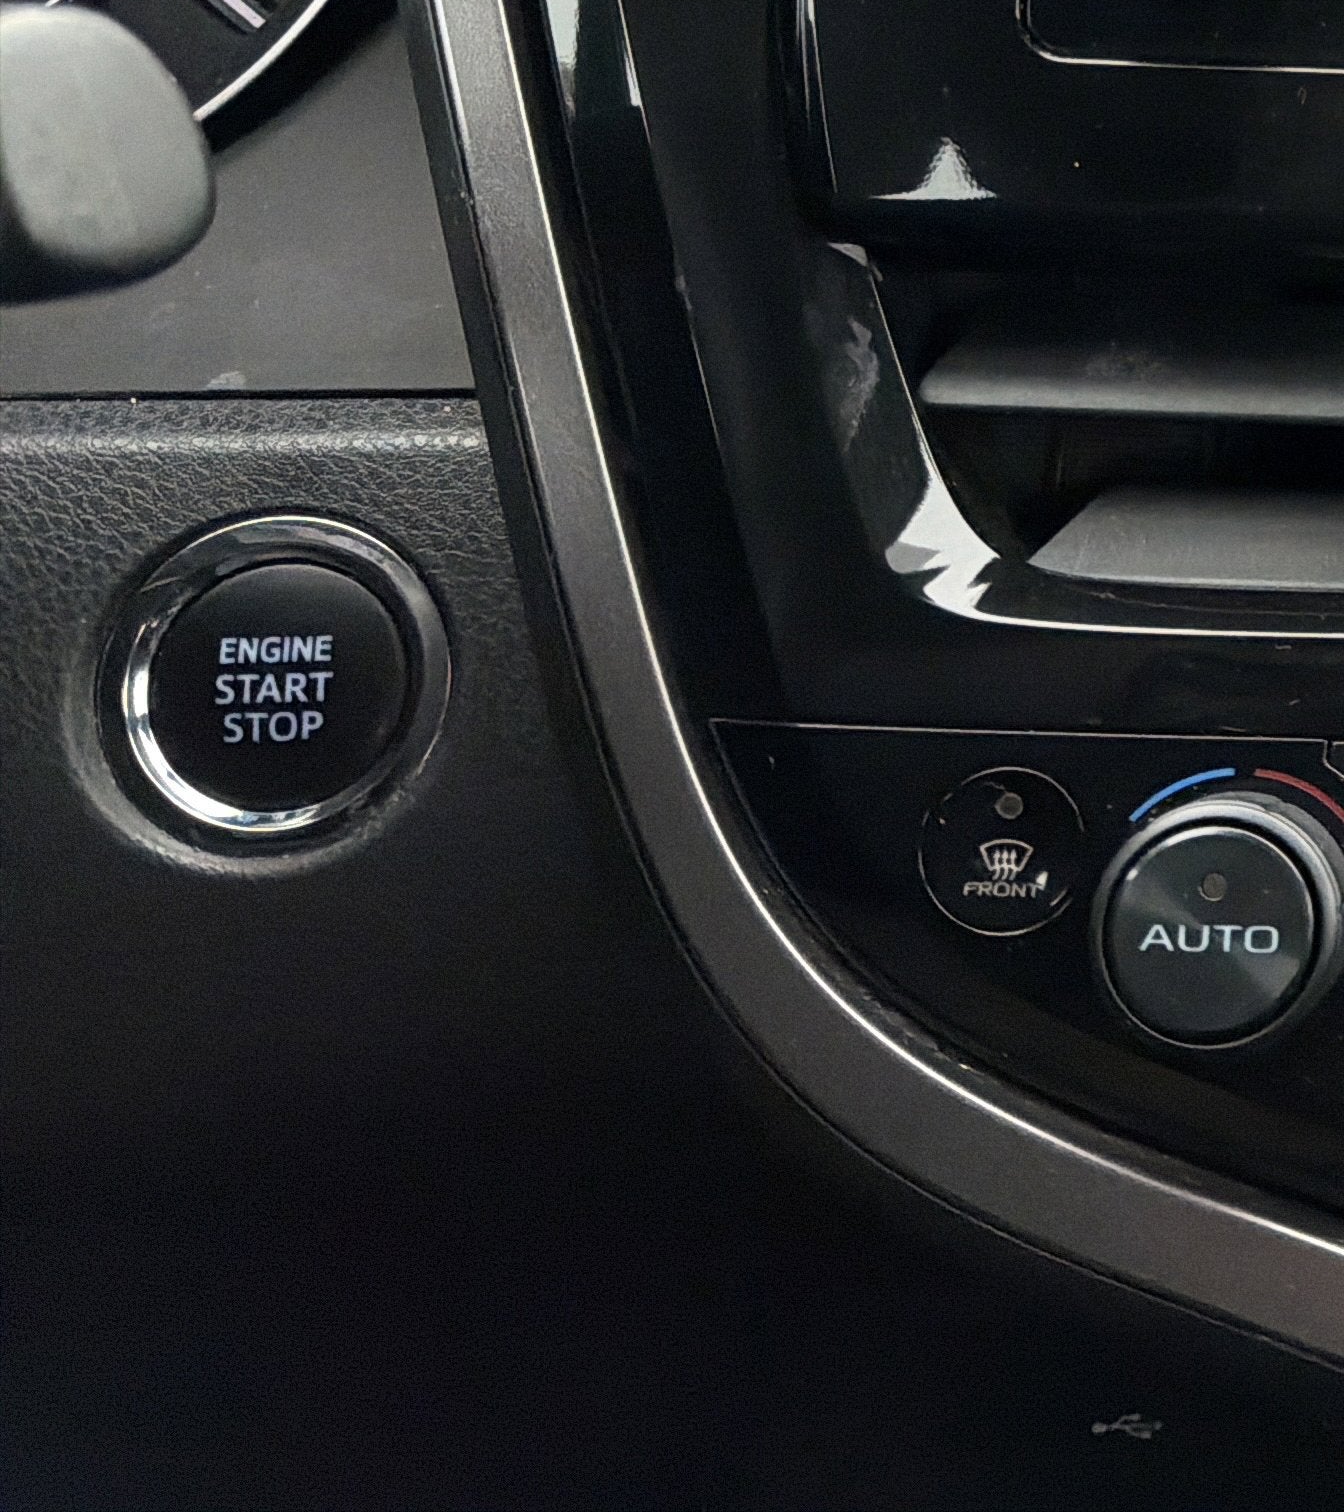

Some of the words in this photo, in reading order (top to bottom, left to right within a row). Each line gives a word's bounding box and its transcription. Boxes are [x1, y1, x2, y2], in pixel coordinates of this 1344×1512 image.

[219, 635, 333, 665] ENGINE
[214, 671, 334, 705] START
[223, 711, 324, 744] STOP
[962, 881, 1046, 899] FRONT
[1138, 924, 1280, 954] AUTO
